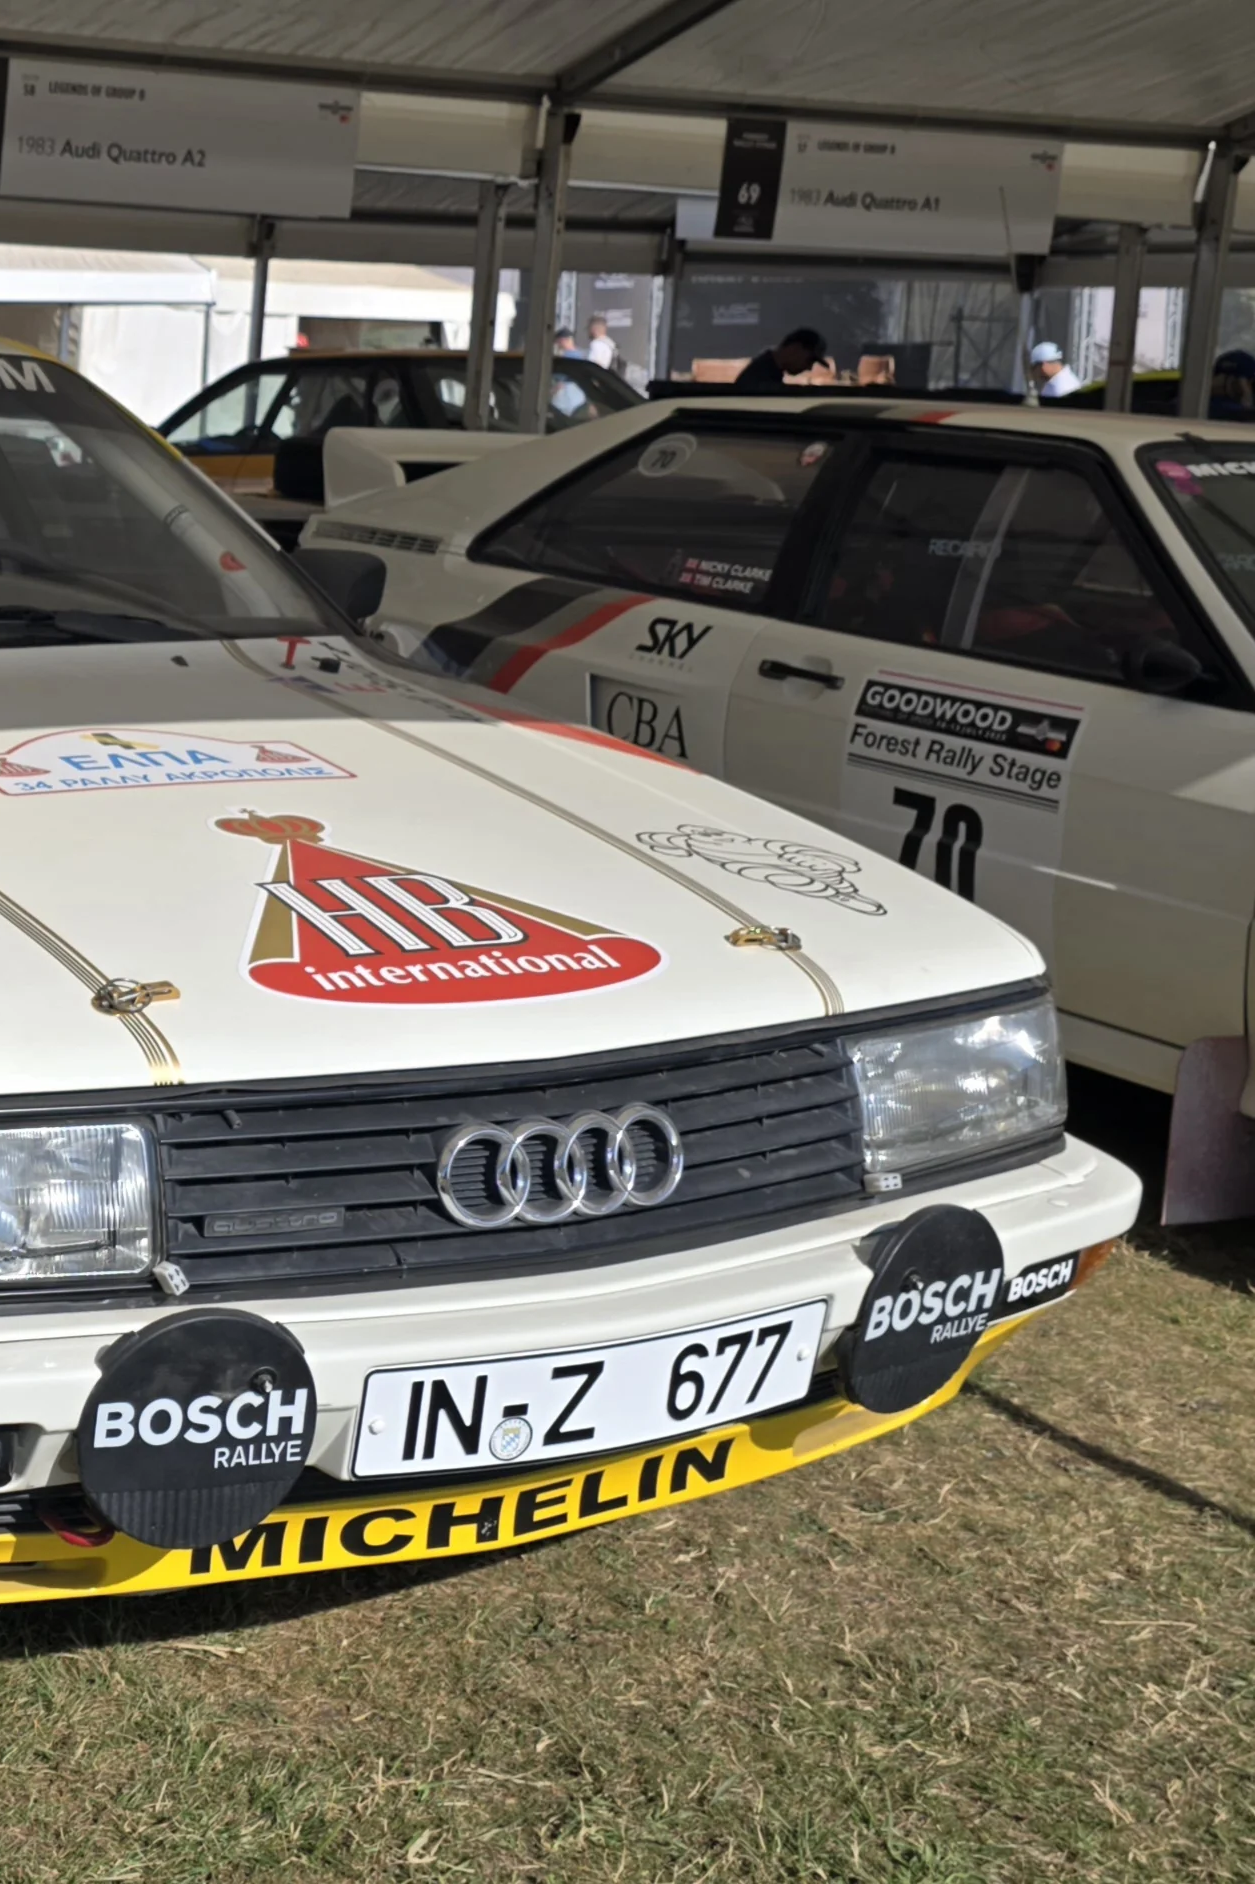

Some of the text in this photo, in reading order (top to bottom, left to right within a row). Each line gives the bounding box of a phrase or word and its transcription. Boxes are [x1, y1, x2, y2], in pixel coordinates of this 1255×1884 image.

[18, 136, 206, 167] 1983 Audi Quattro A2
[737, 182, 761, 205] 69
[823, 189, 858, 208] Audi
[861, 192, 918, 211] Quattro
[920, 196, 941, 211] A1
[634, 617, 714, 659] SKY
[606, 691, 689, 760] CBA
[866, 686, 1013, 732] GOODWOOD
[58, 749, 233, 771] ΕΛΠΑ
[849, 723, 1062, 791] Forest Rally Stage
[13, 780, 53, 791] 34
[892, 786, 984, 902] 70
[254, 873, 530, 957] HB
[305, 944, 621, 991] international
[213, 1211, 338, 1233] quattro
[1007, 1258, 1074, 1303] BOSCH
[864, 1267, 1002, 1342] BOSCH
[930, 1313, 990, 1344] RALLYE
[666, 1320, 794, 1422] 677
[93, 1388, 308, 1448] BOSCH
[214, 1440, 302, 1469] RALLYE
[190, 1437, 736, 1575] MICHELIN
